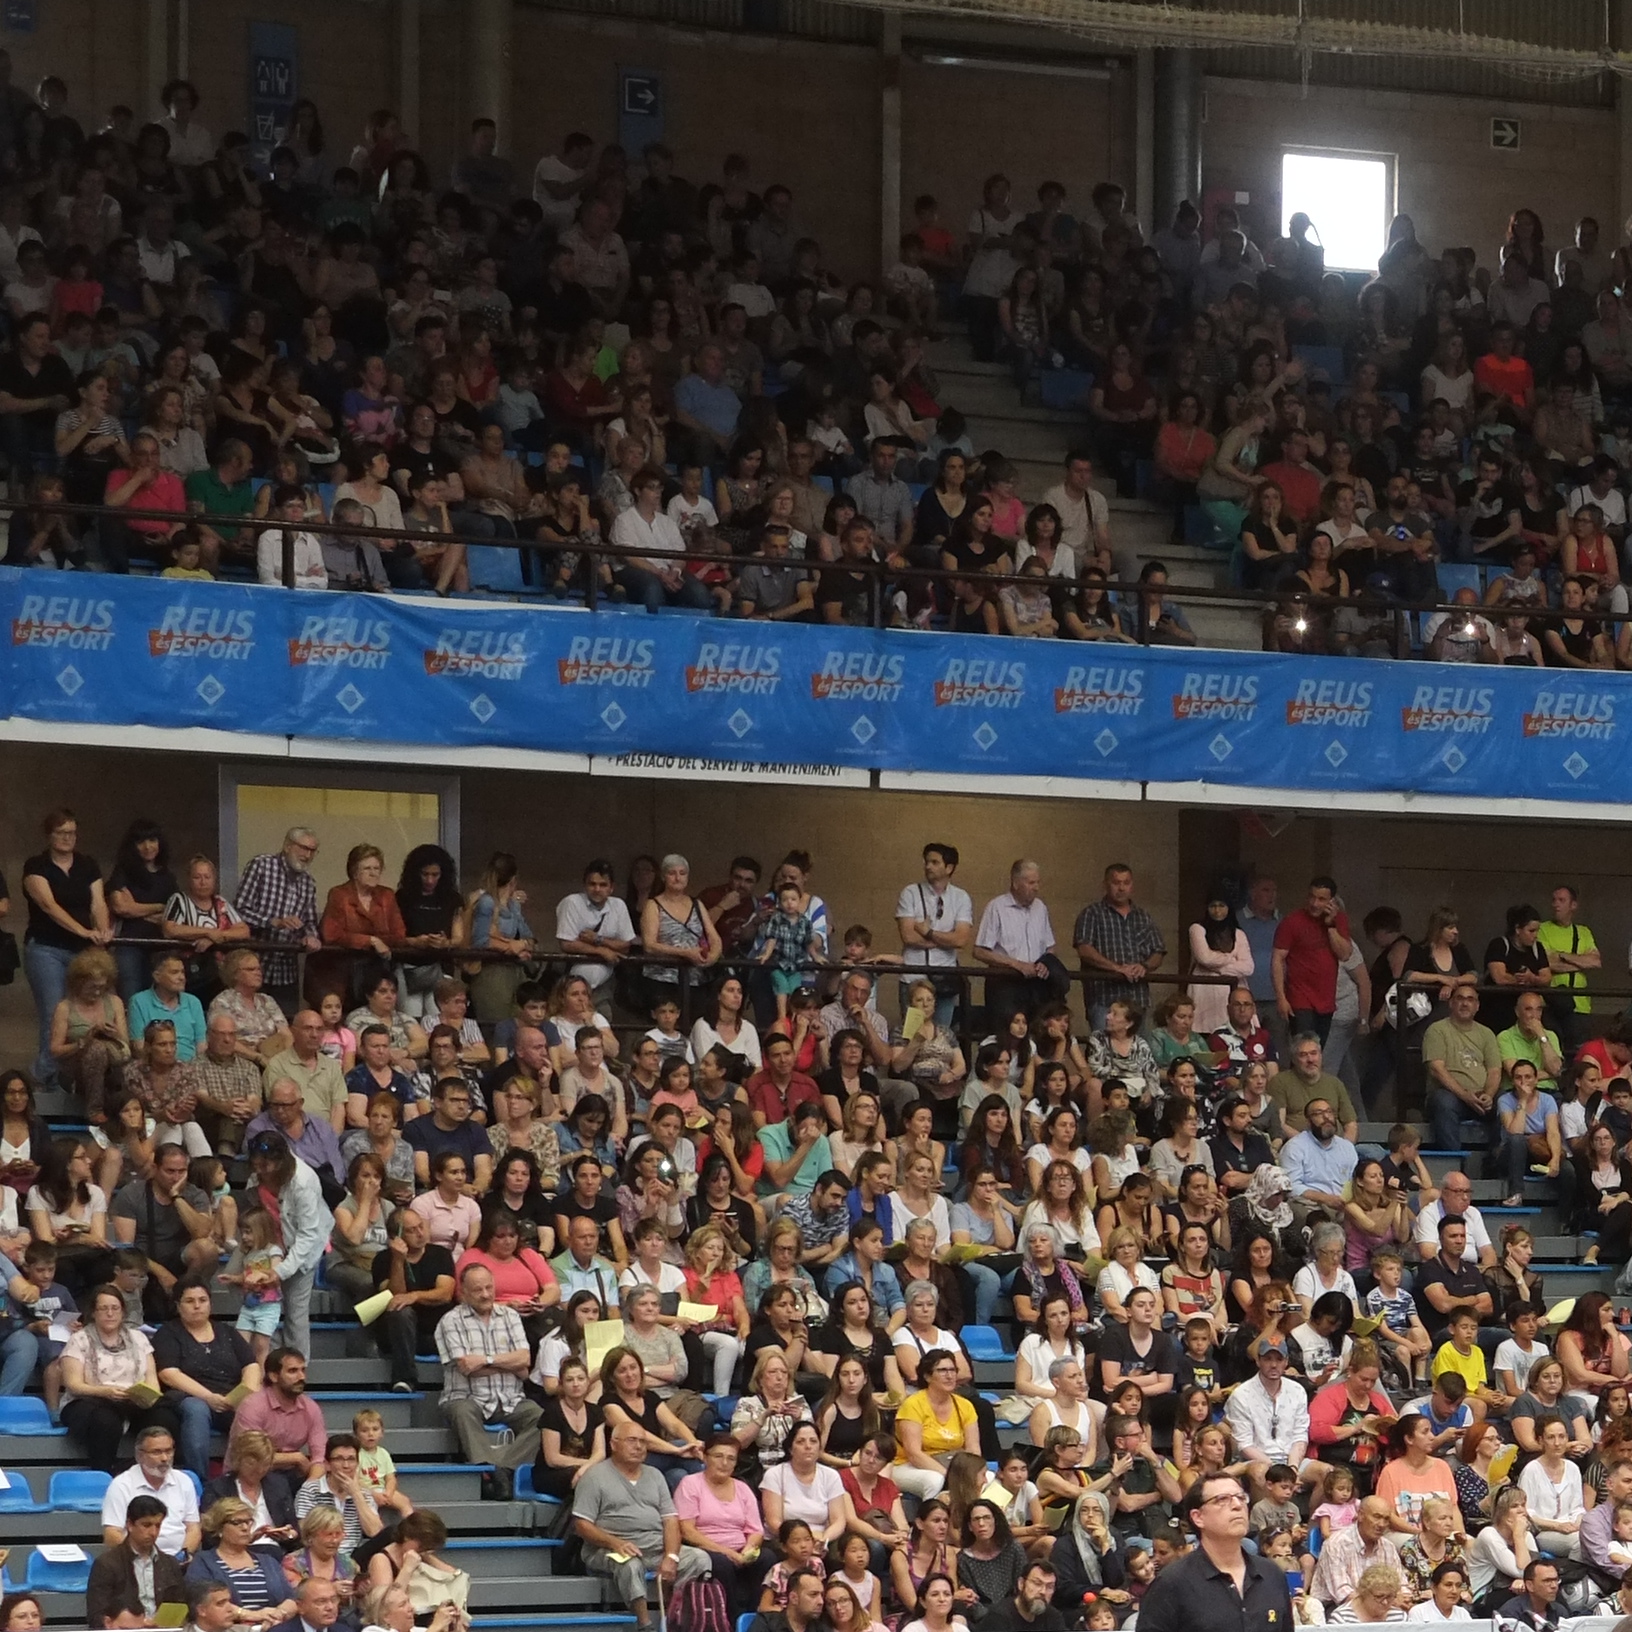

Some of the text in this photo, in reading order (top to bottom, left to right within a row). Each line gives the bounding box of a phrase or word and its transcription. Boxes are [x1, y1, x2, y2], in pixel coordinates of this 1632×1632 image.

[19, 596, 115, 631] REUS
[29, 626, 115, 651] ESPORT
[299, 615, 392, 650] REUS
[308, 647, 392, 669] ESPORT
[567, 636, 655, 669] REUS
[695, 643, 781, 675] REUS
[576, 665, 655, 688] ESPORT
[703, 672, 781, 695] ESPORT
[1064, 666, 1144, 697] REUS
[1071, 695, 1144, 716] ESPORT
[1411, 685, 1494, 716] REUS
[1419, 714, 1493, 734] ESPORT
